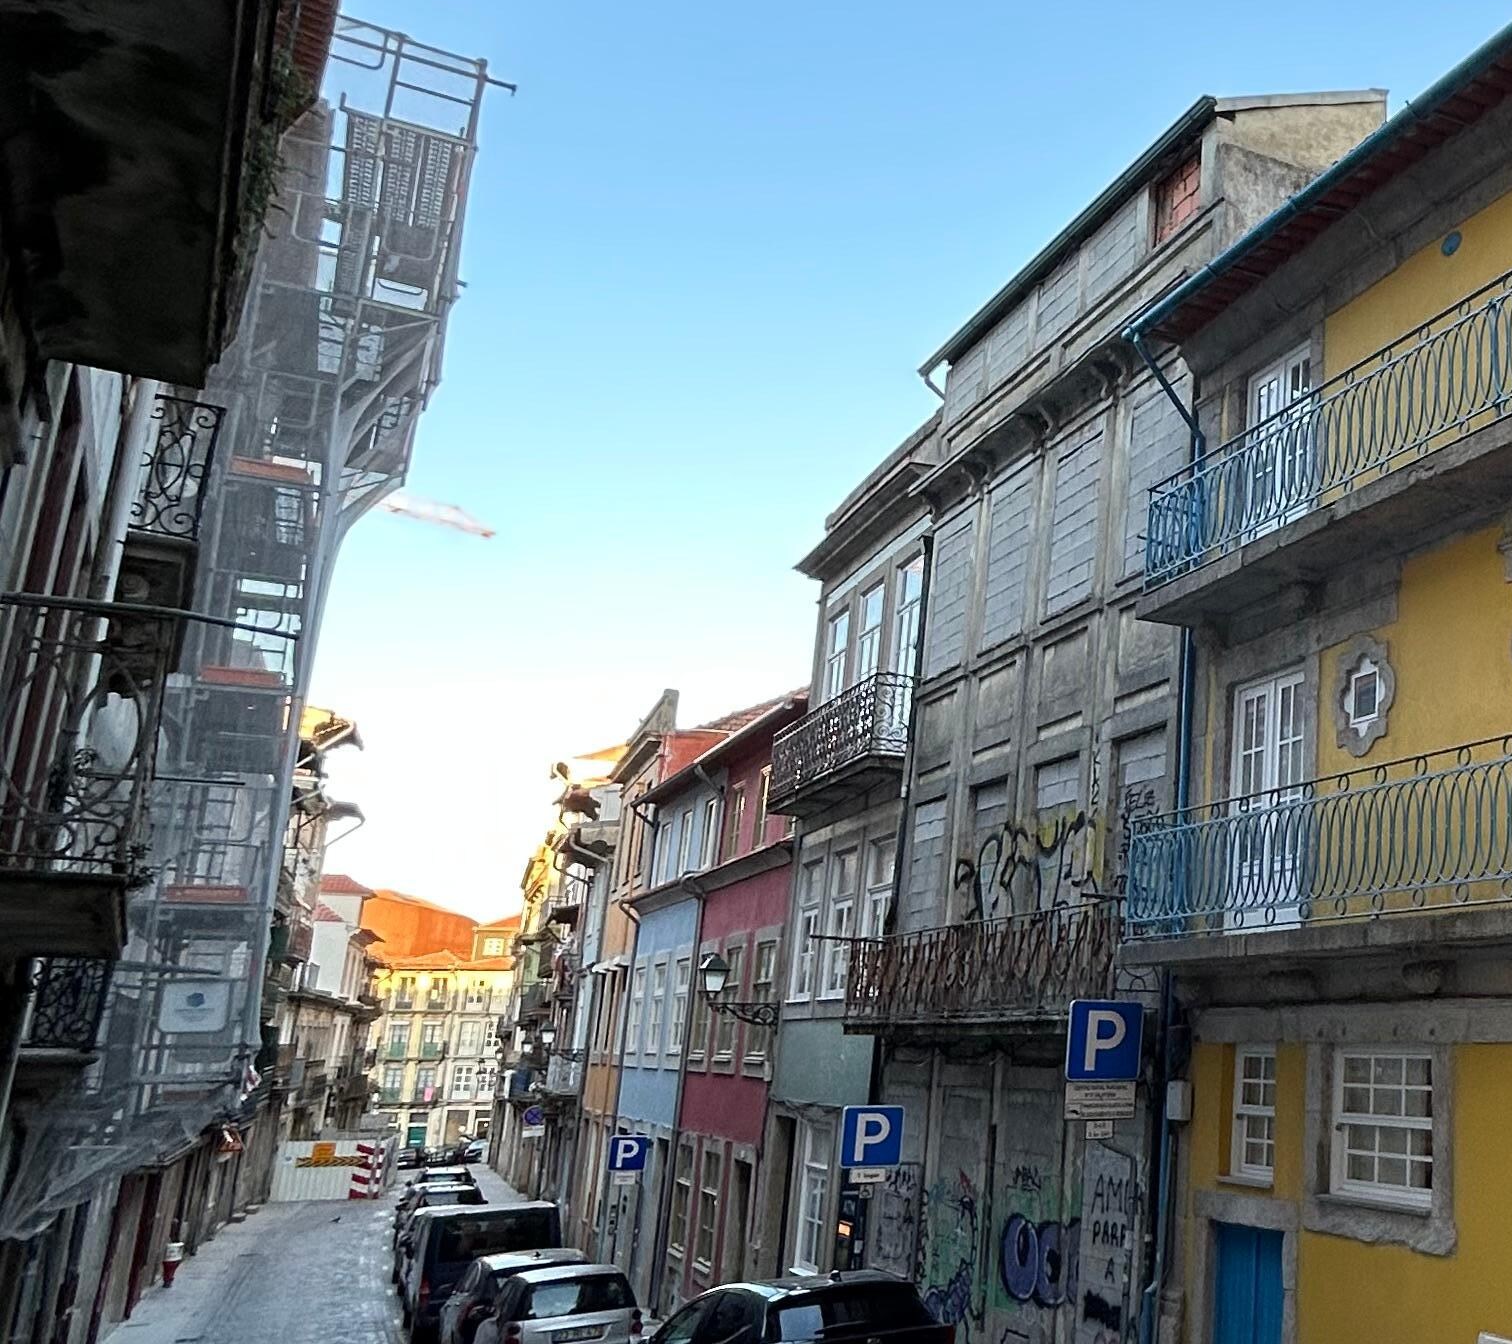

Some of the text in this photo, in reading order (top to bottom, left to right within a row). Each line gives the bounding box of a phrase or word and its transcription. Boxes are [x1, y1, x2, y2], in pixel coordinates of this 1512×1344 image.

[1084, 1009, 1127, 1072] P
[615, 1139, 640, 1168] P
[853, 1113, 891, 1162] P
